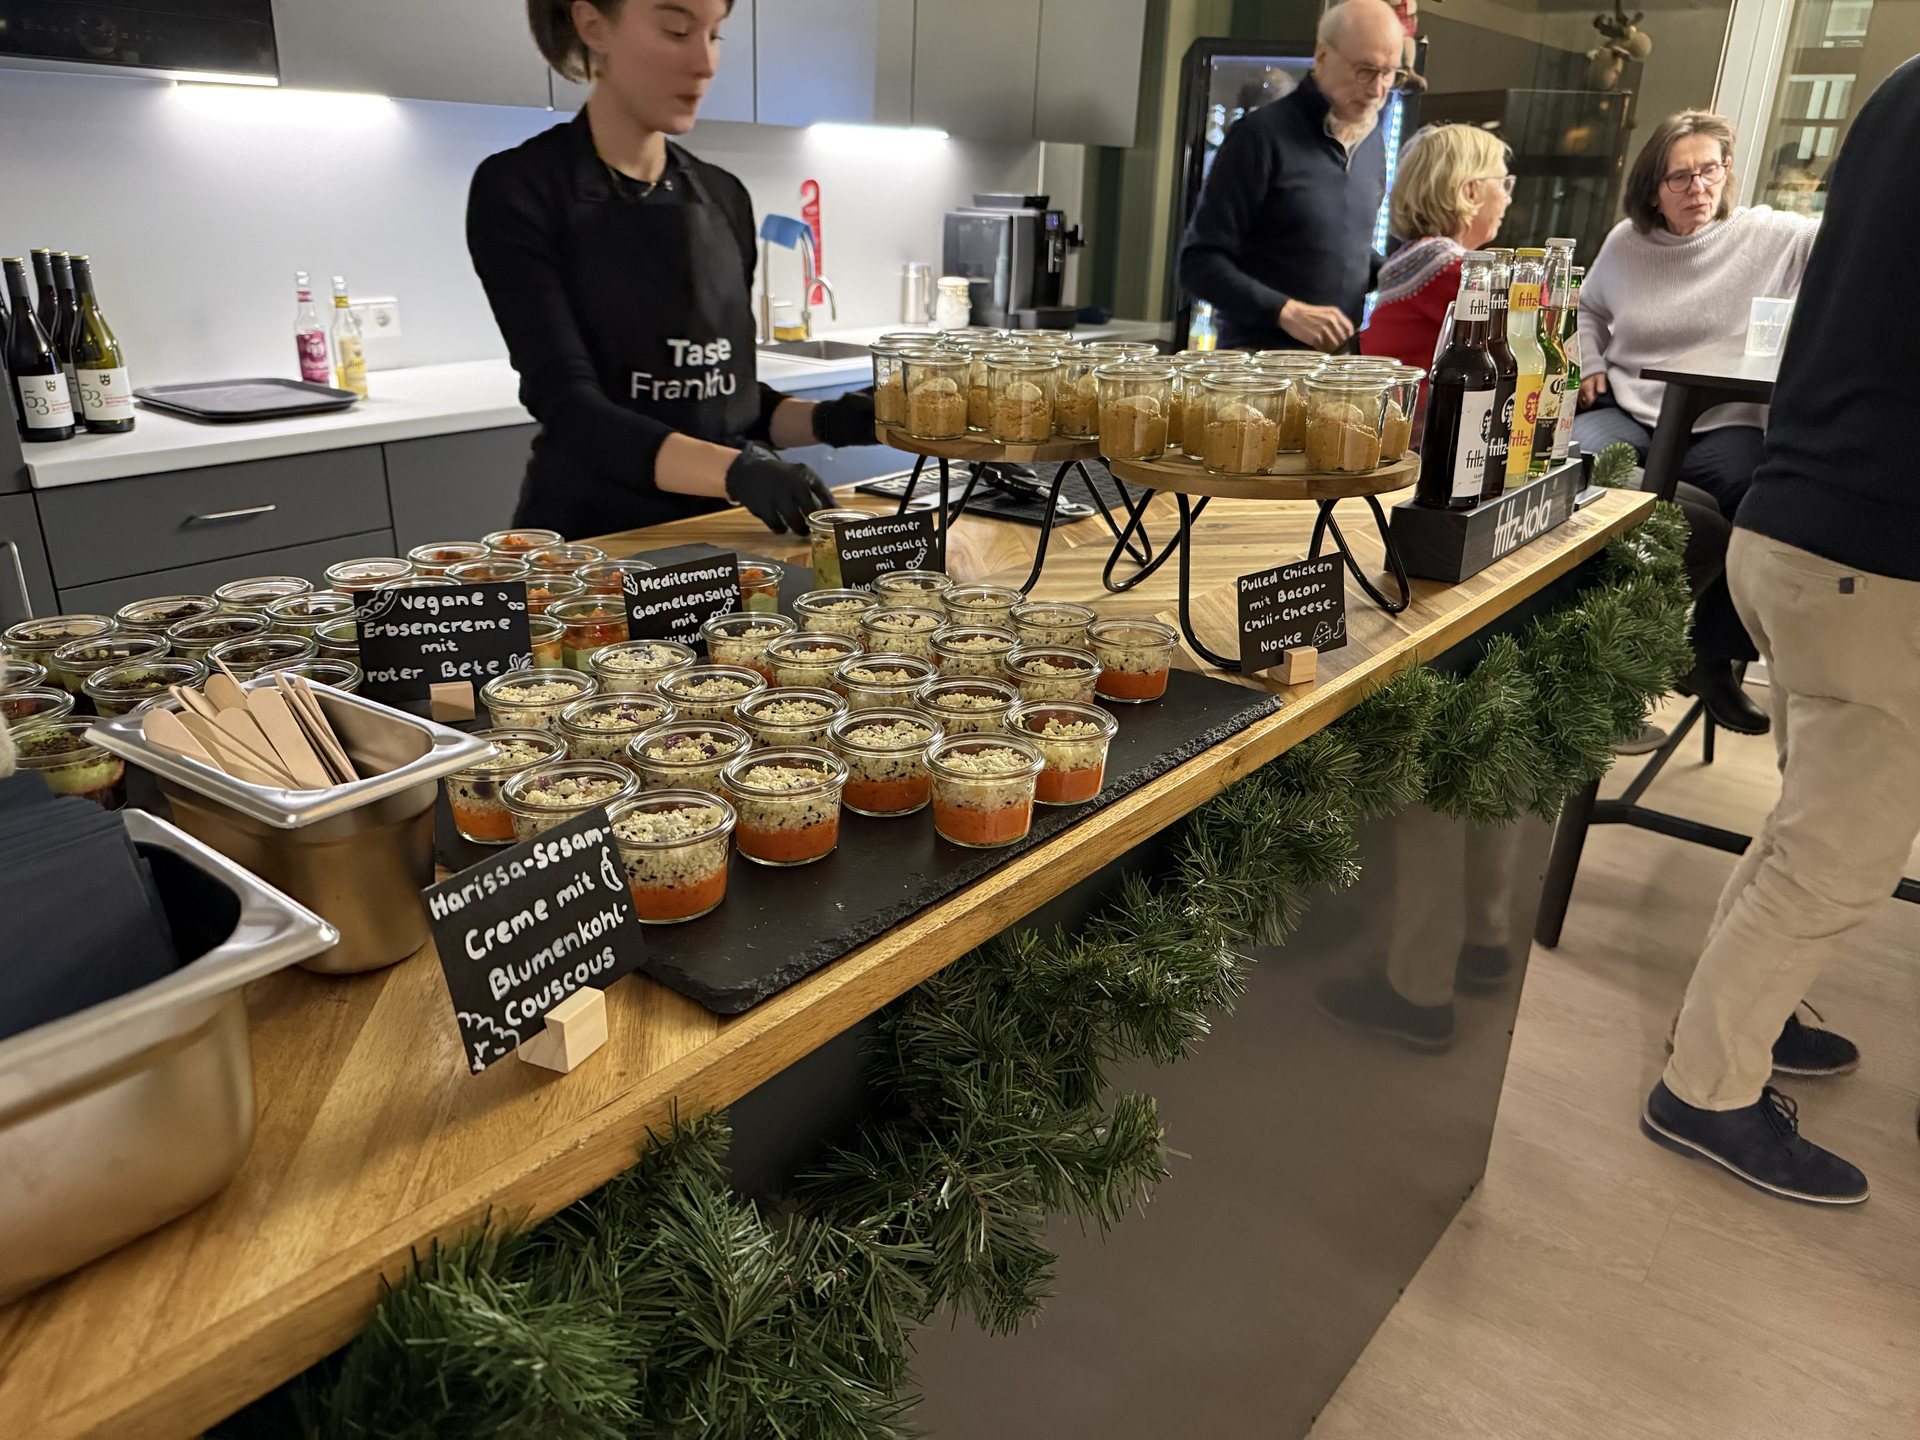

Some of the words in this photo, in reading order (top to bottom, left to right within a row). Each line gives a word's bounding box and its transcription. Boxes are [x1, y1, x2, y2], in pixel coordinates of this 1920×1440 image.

[24, 390, 49, 415] 53
[81, 383, 103, 408] 53
[844, 521, 920, 540] Mediterraner
[842, 536, 929, 561] Garnelensalat
[875, 559, 896, 571] mit
[1241, 571, 1278, 593] Pulled
[1282, 562, 1333, 580] Chicken
[640, 566, 733, 592] Mediterraner
[632, 583, 741, 620] Garnelensalat
[1249, 595, 1271, 611] mit
[1277, 583, 1326, 603] Bacon-
[363, 617, 511, 639] Erbsencreme
[671, 612, 698, 629] mit
[1244, 598, 1337, 633] Chili-Cheese-
[421, 638, 459, 654] mit
[1260, 632, 1302, 653] Nocke
[366, 667, 424, 683] roter
[440, 659, 500, 679] Bete
[465, 899, 549, 960] Creme
[556, 871, 596, 908] mit
